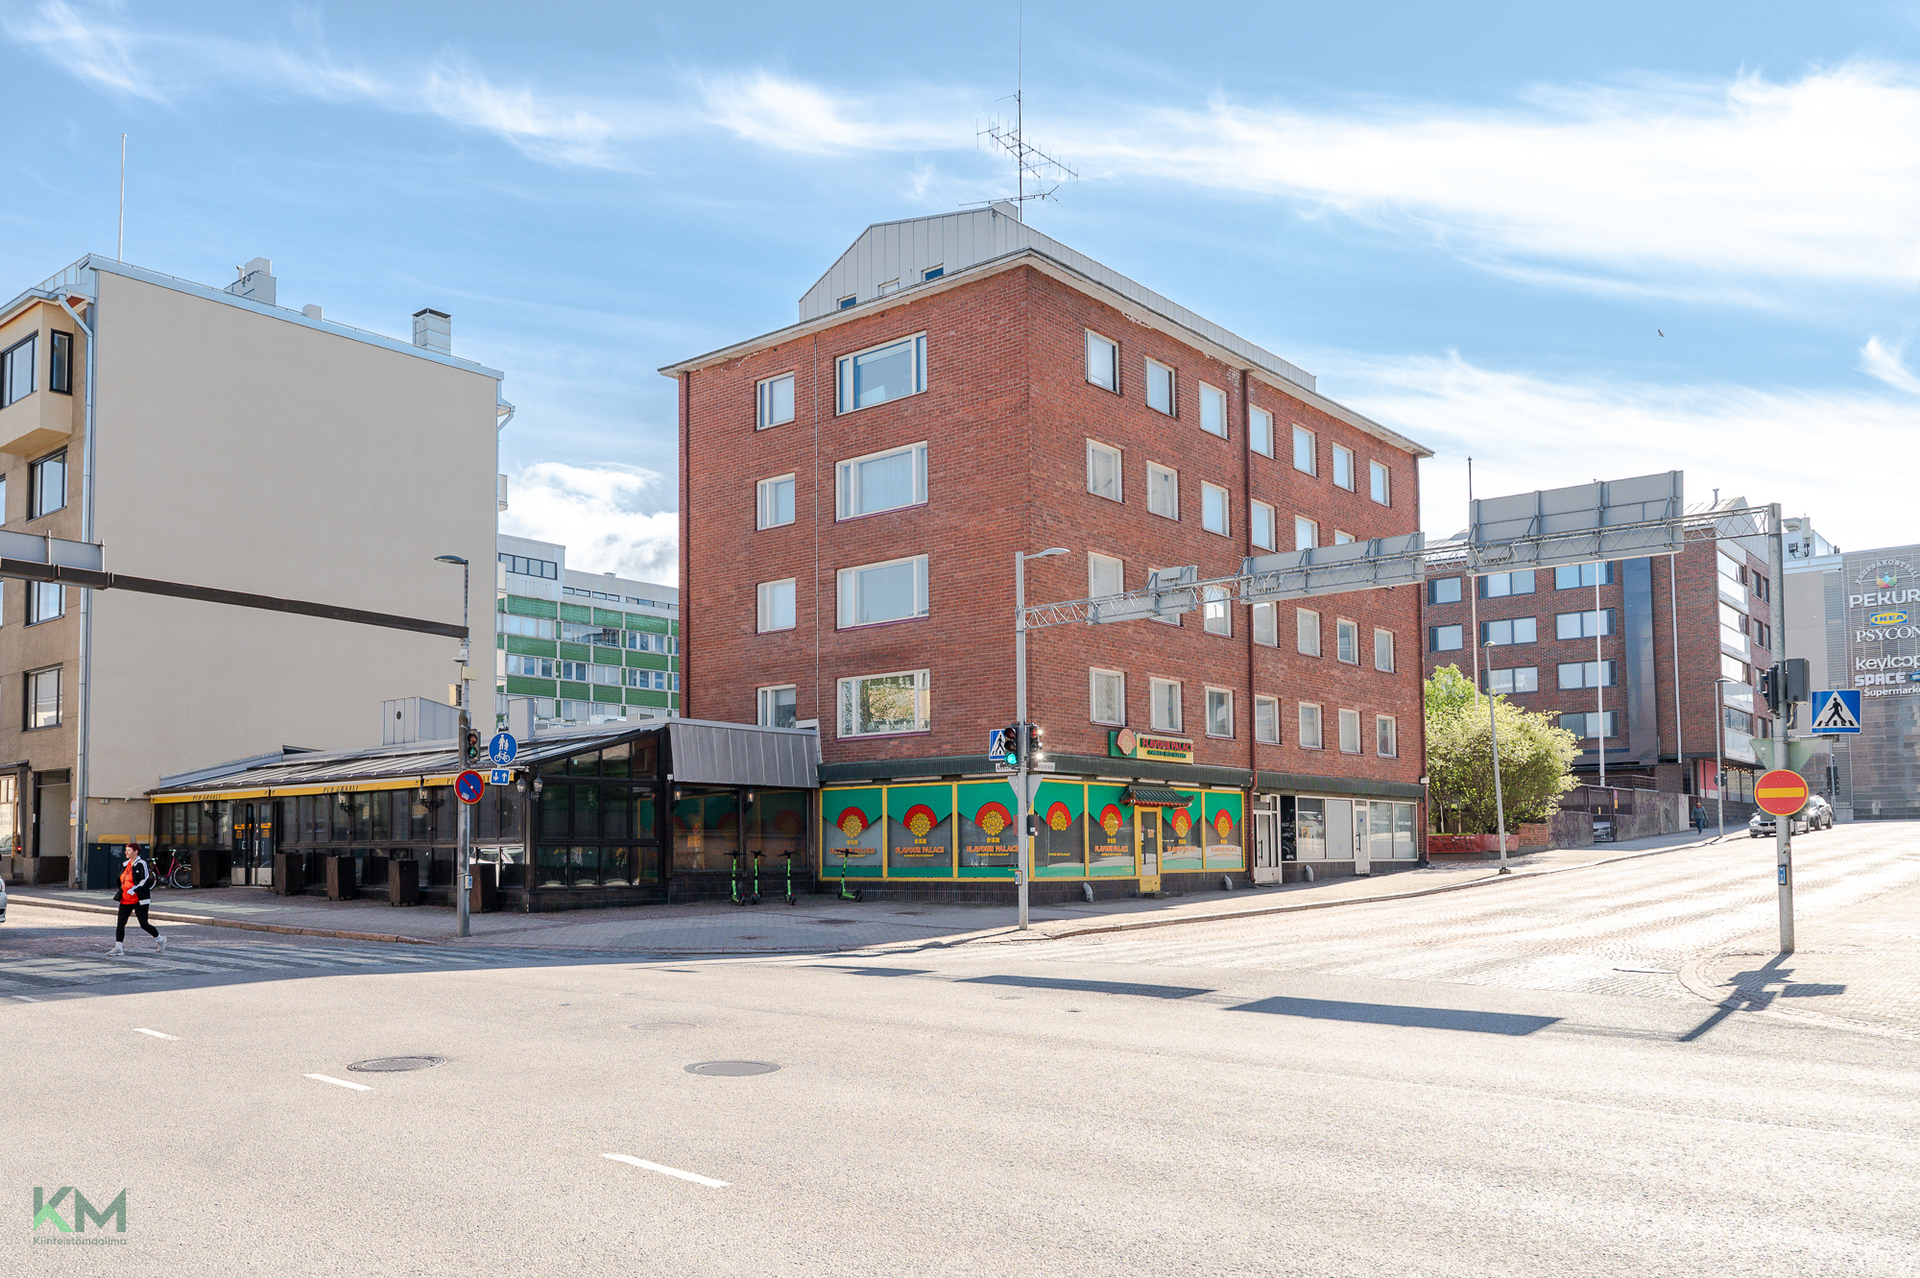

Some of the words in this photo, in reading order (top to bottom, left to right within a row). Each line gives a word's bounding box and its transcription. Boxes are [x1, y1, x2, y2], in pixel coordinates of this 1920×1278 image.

[1855, 671, 1907, 687] SPACE
[1864, 684, 1920, 698] Supermark
[1142, 738, 1171, 750] FLAVOUR
[1171, 741, 1193, 752] PALACE
